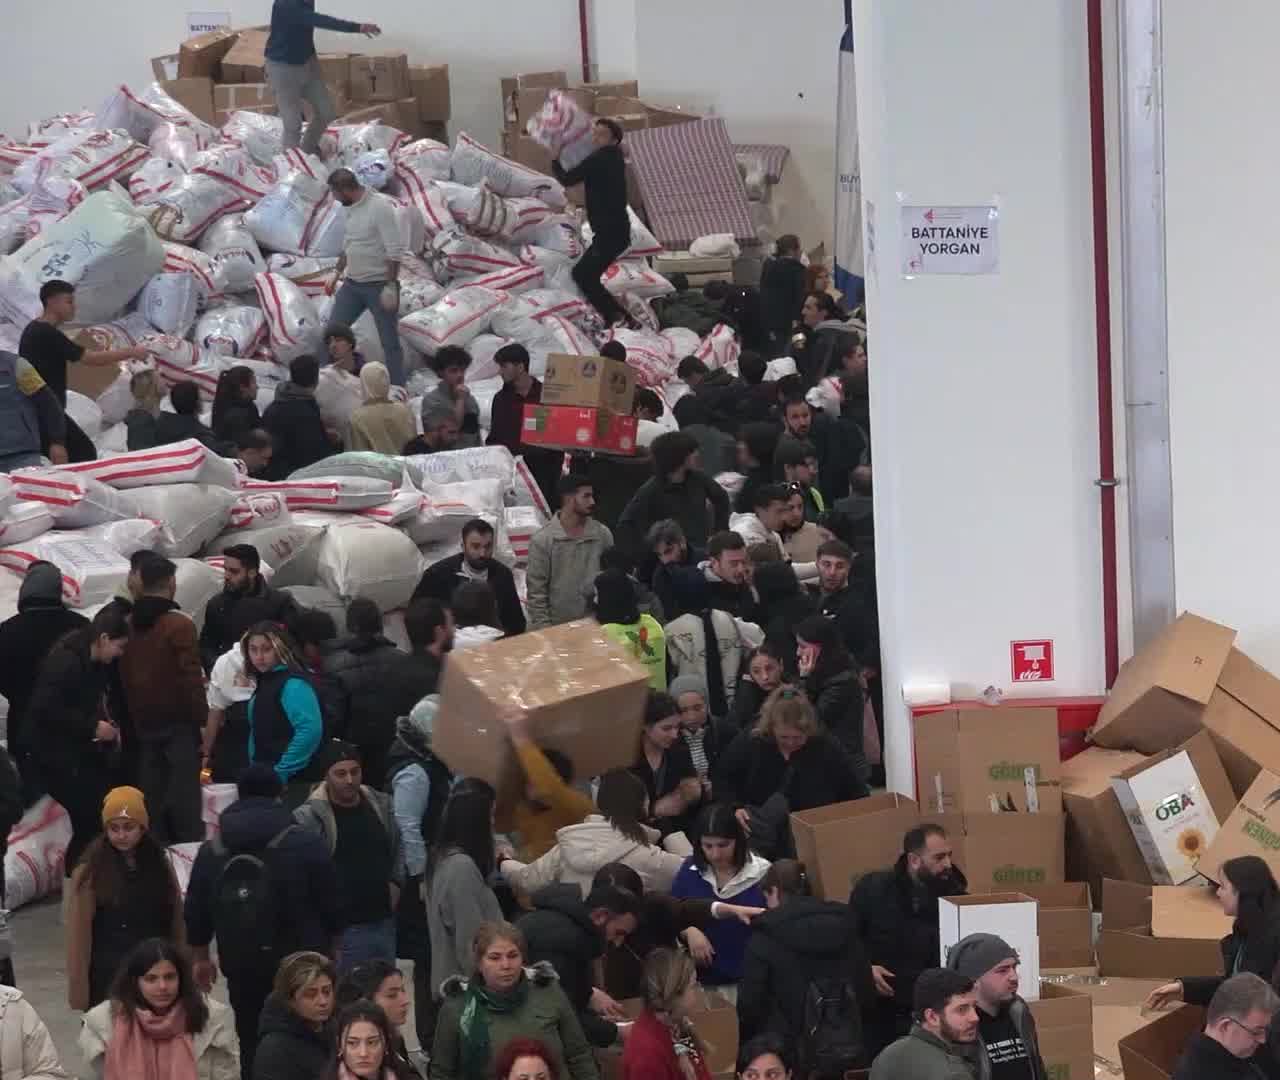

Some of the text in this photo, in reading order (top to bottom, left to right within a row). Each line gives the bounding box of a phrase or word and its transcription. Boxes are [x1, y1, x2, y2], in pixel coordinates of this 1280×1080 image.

[911, 224, 989, 239] BATTANİYE
[920, 242, 981, 255] YORGAN
[1155, 792, 1196, 822] OBA
